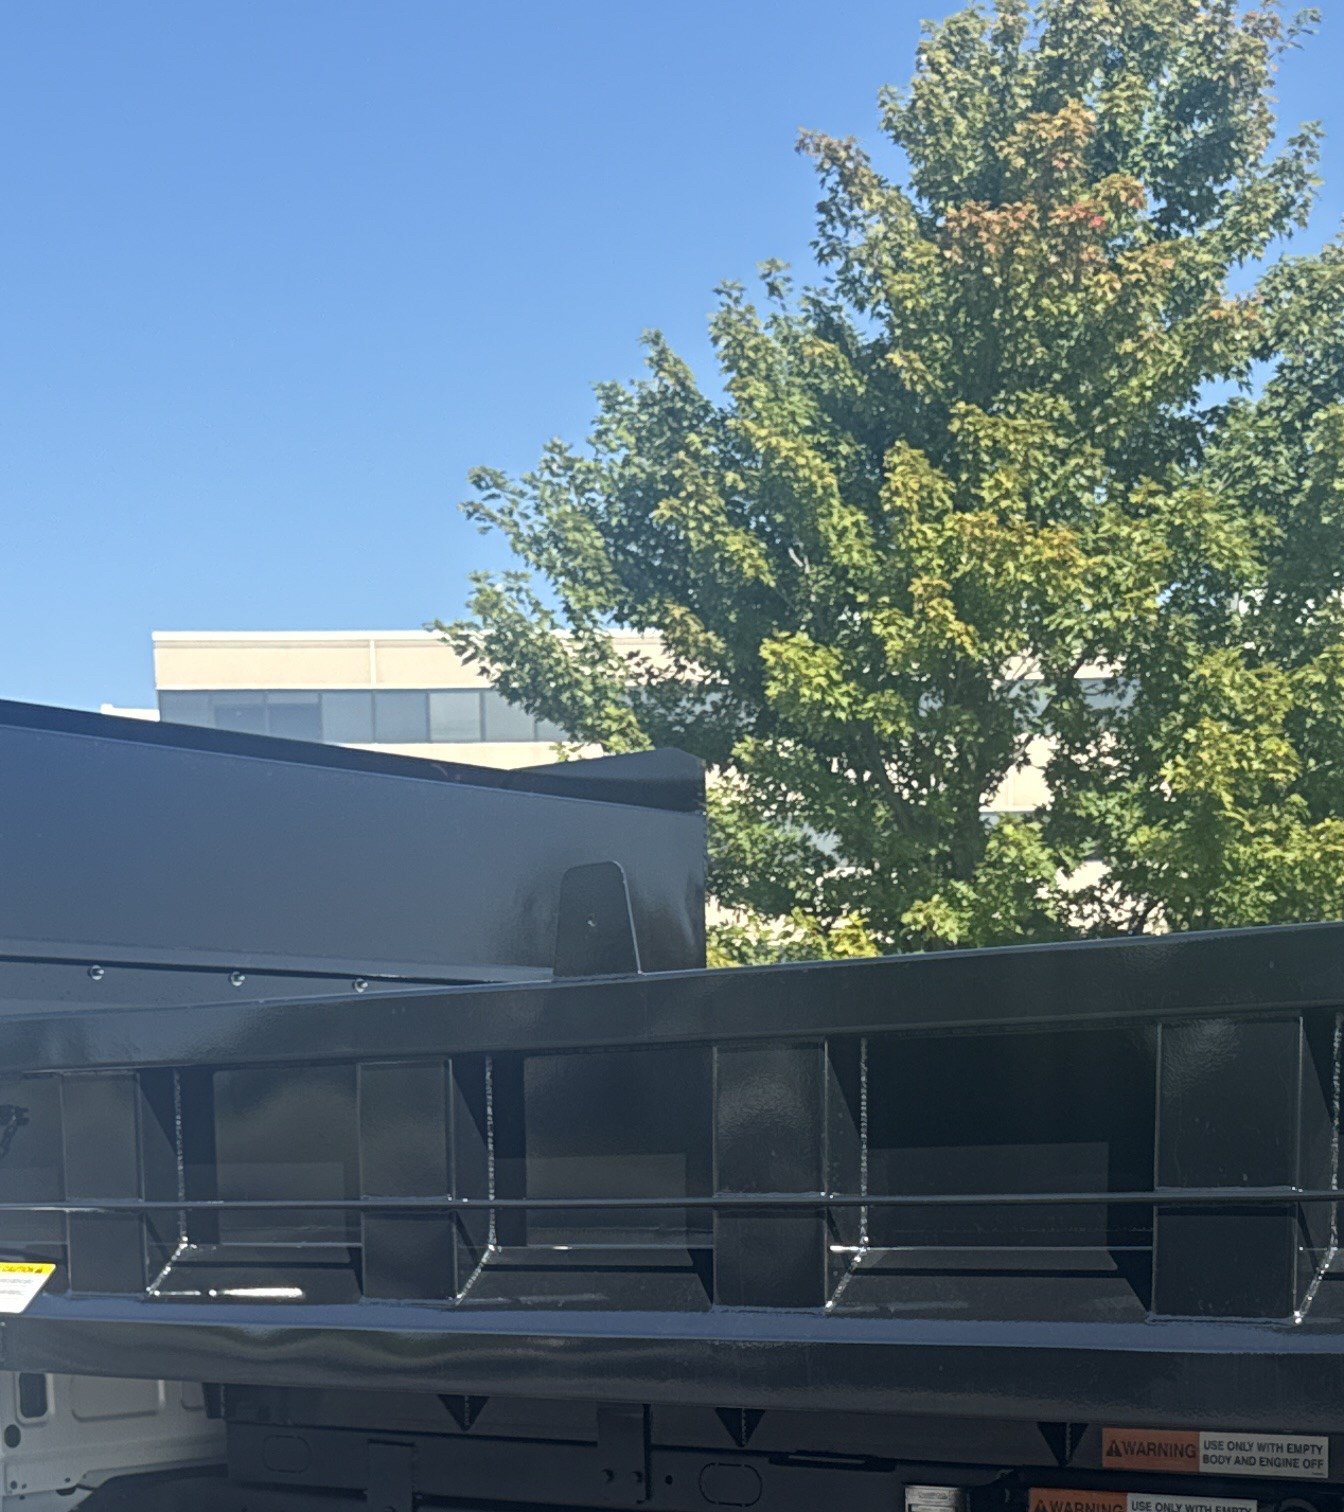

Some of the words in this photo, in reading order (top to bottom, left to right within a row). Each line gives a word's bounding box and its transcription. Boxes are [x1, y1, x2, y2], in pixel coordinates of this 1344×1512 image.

[1122, 1439, 1197, 1459] WARNING
[1203, 1439, 1225, 1451] USE
[1226, 1440, 1254, 1453] ONLY
[1255, 1441, 1284, 1454] WITH
[1286, 1442, 1324, 1456] EMPTY
[1202, 1454, 1231, 1466] BODY
[1233, 1455, 1257, 1467] AND
[1258, 1457, 1300, 1469] ENGINE
[1302, 1458, 1325, 1469] OFF
[1130, 1500, 1152, 1512] USE
